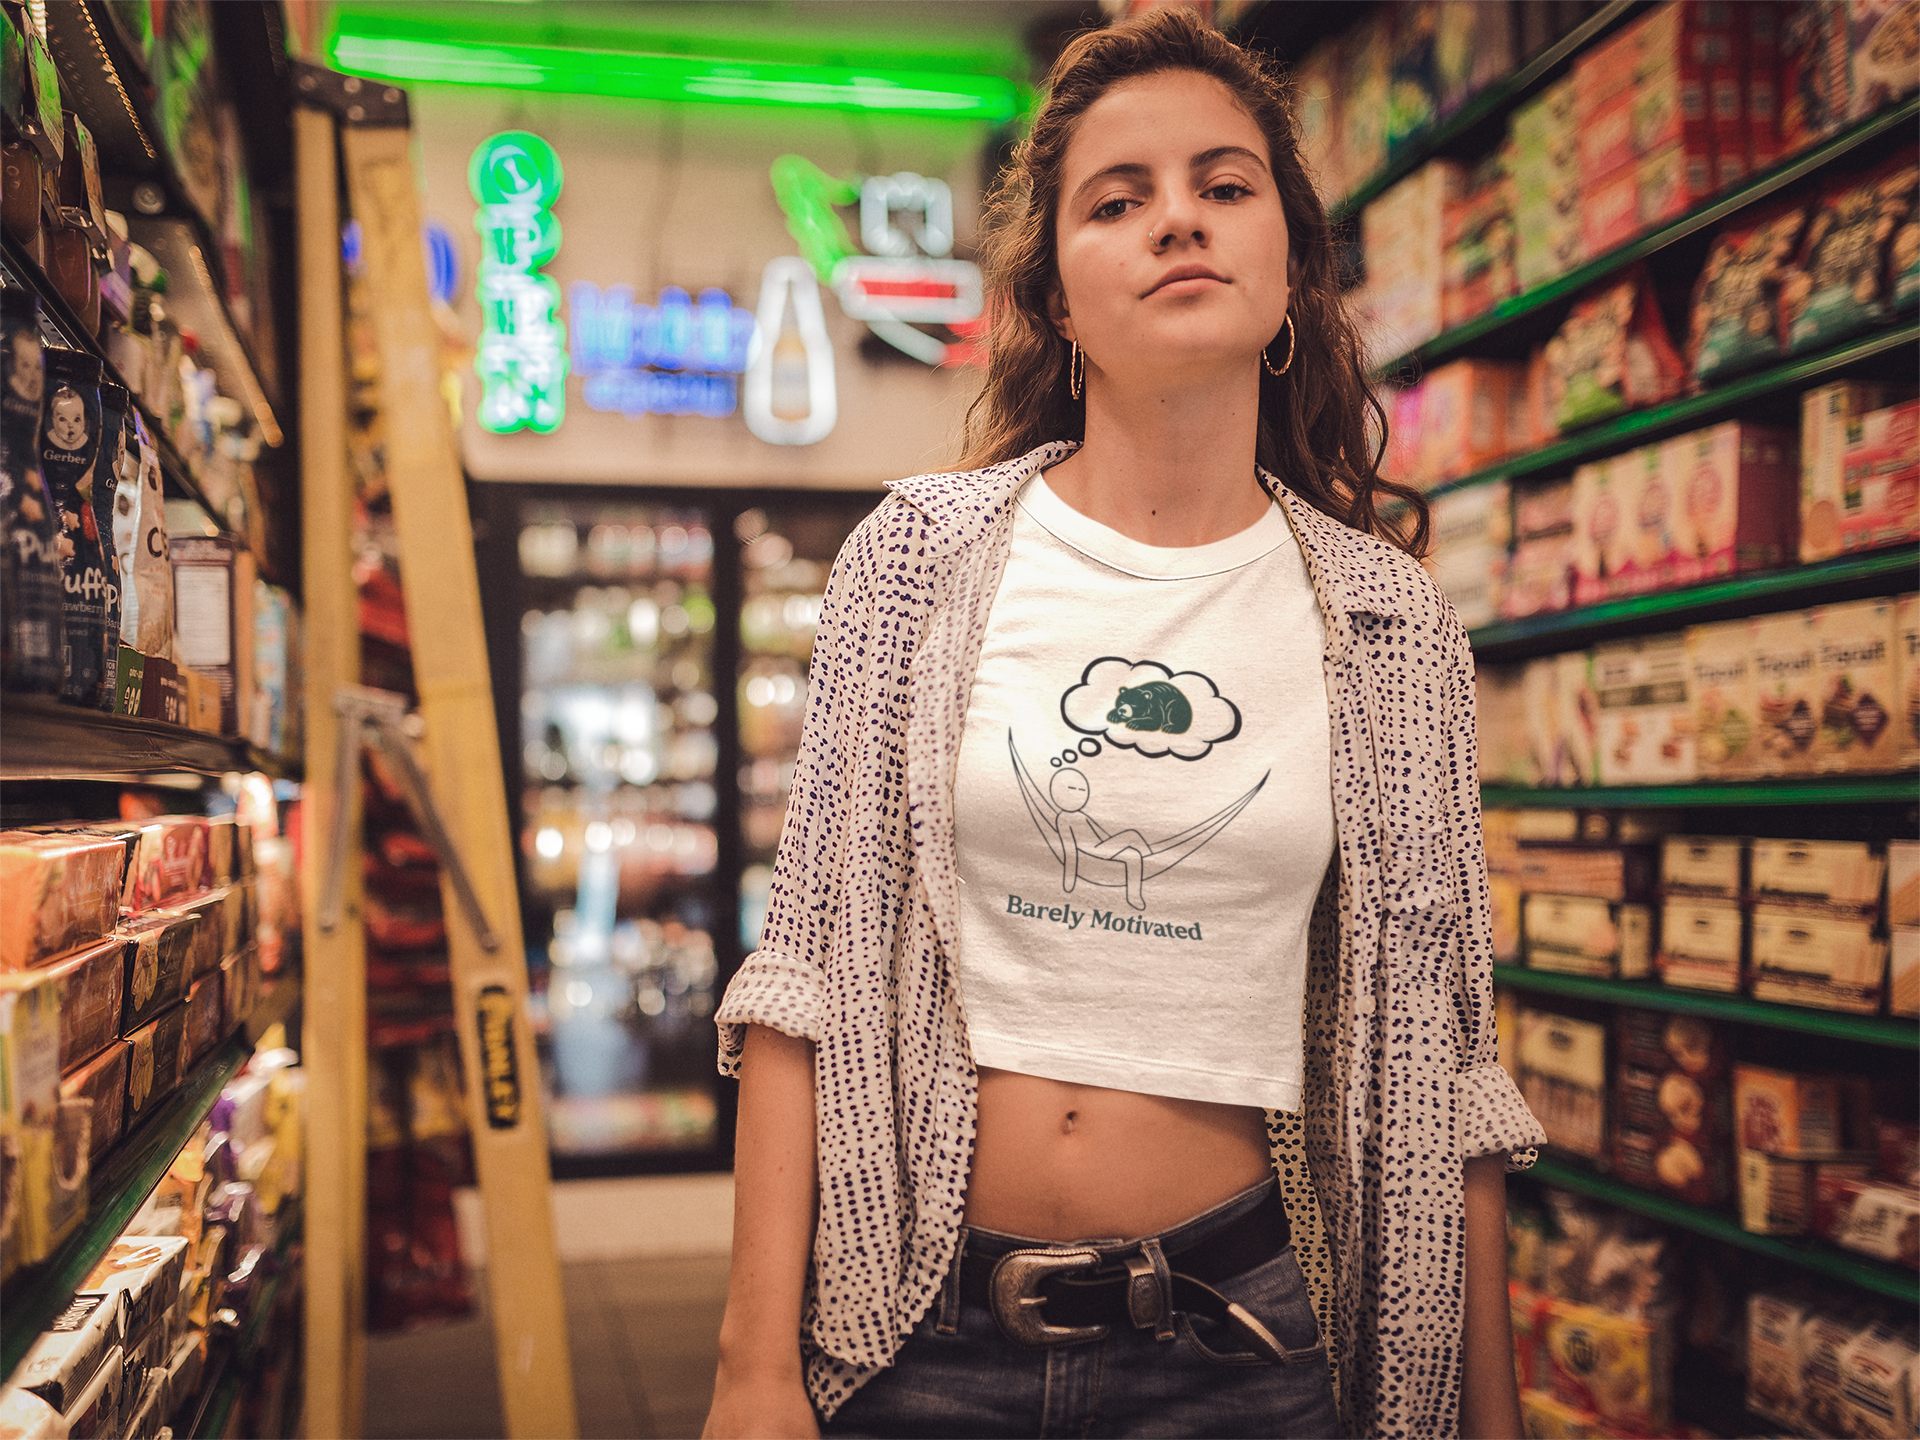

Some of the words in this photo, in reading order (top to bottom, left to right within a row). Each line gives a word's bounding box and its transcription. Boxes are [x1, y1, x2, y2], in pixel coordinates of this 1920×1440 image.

[43, 449, 87, 464] Gerber
[1006, 895, 1085, 930] Barely
[1090, 909, 1203, 941] Motivated
